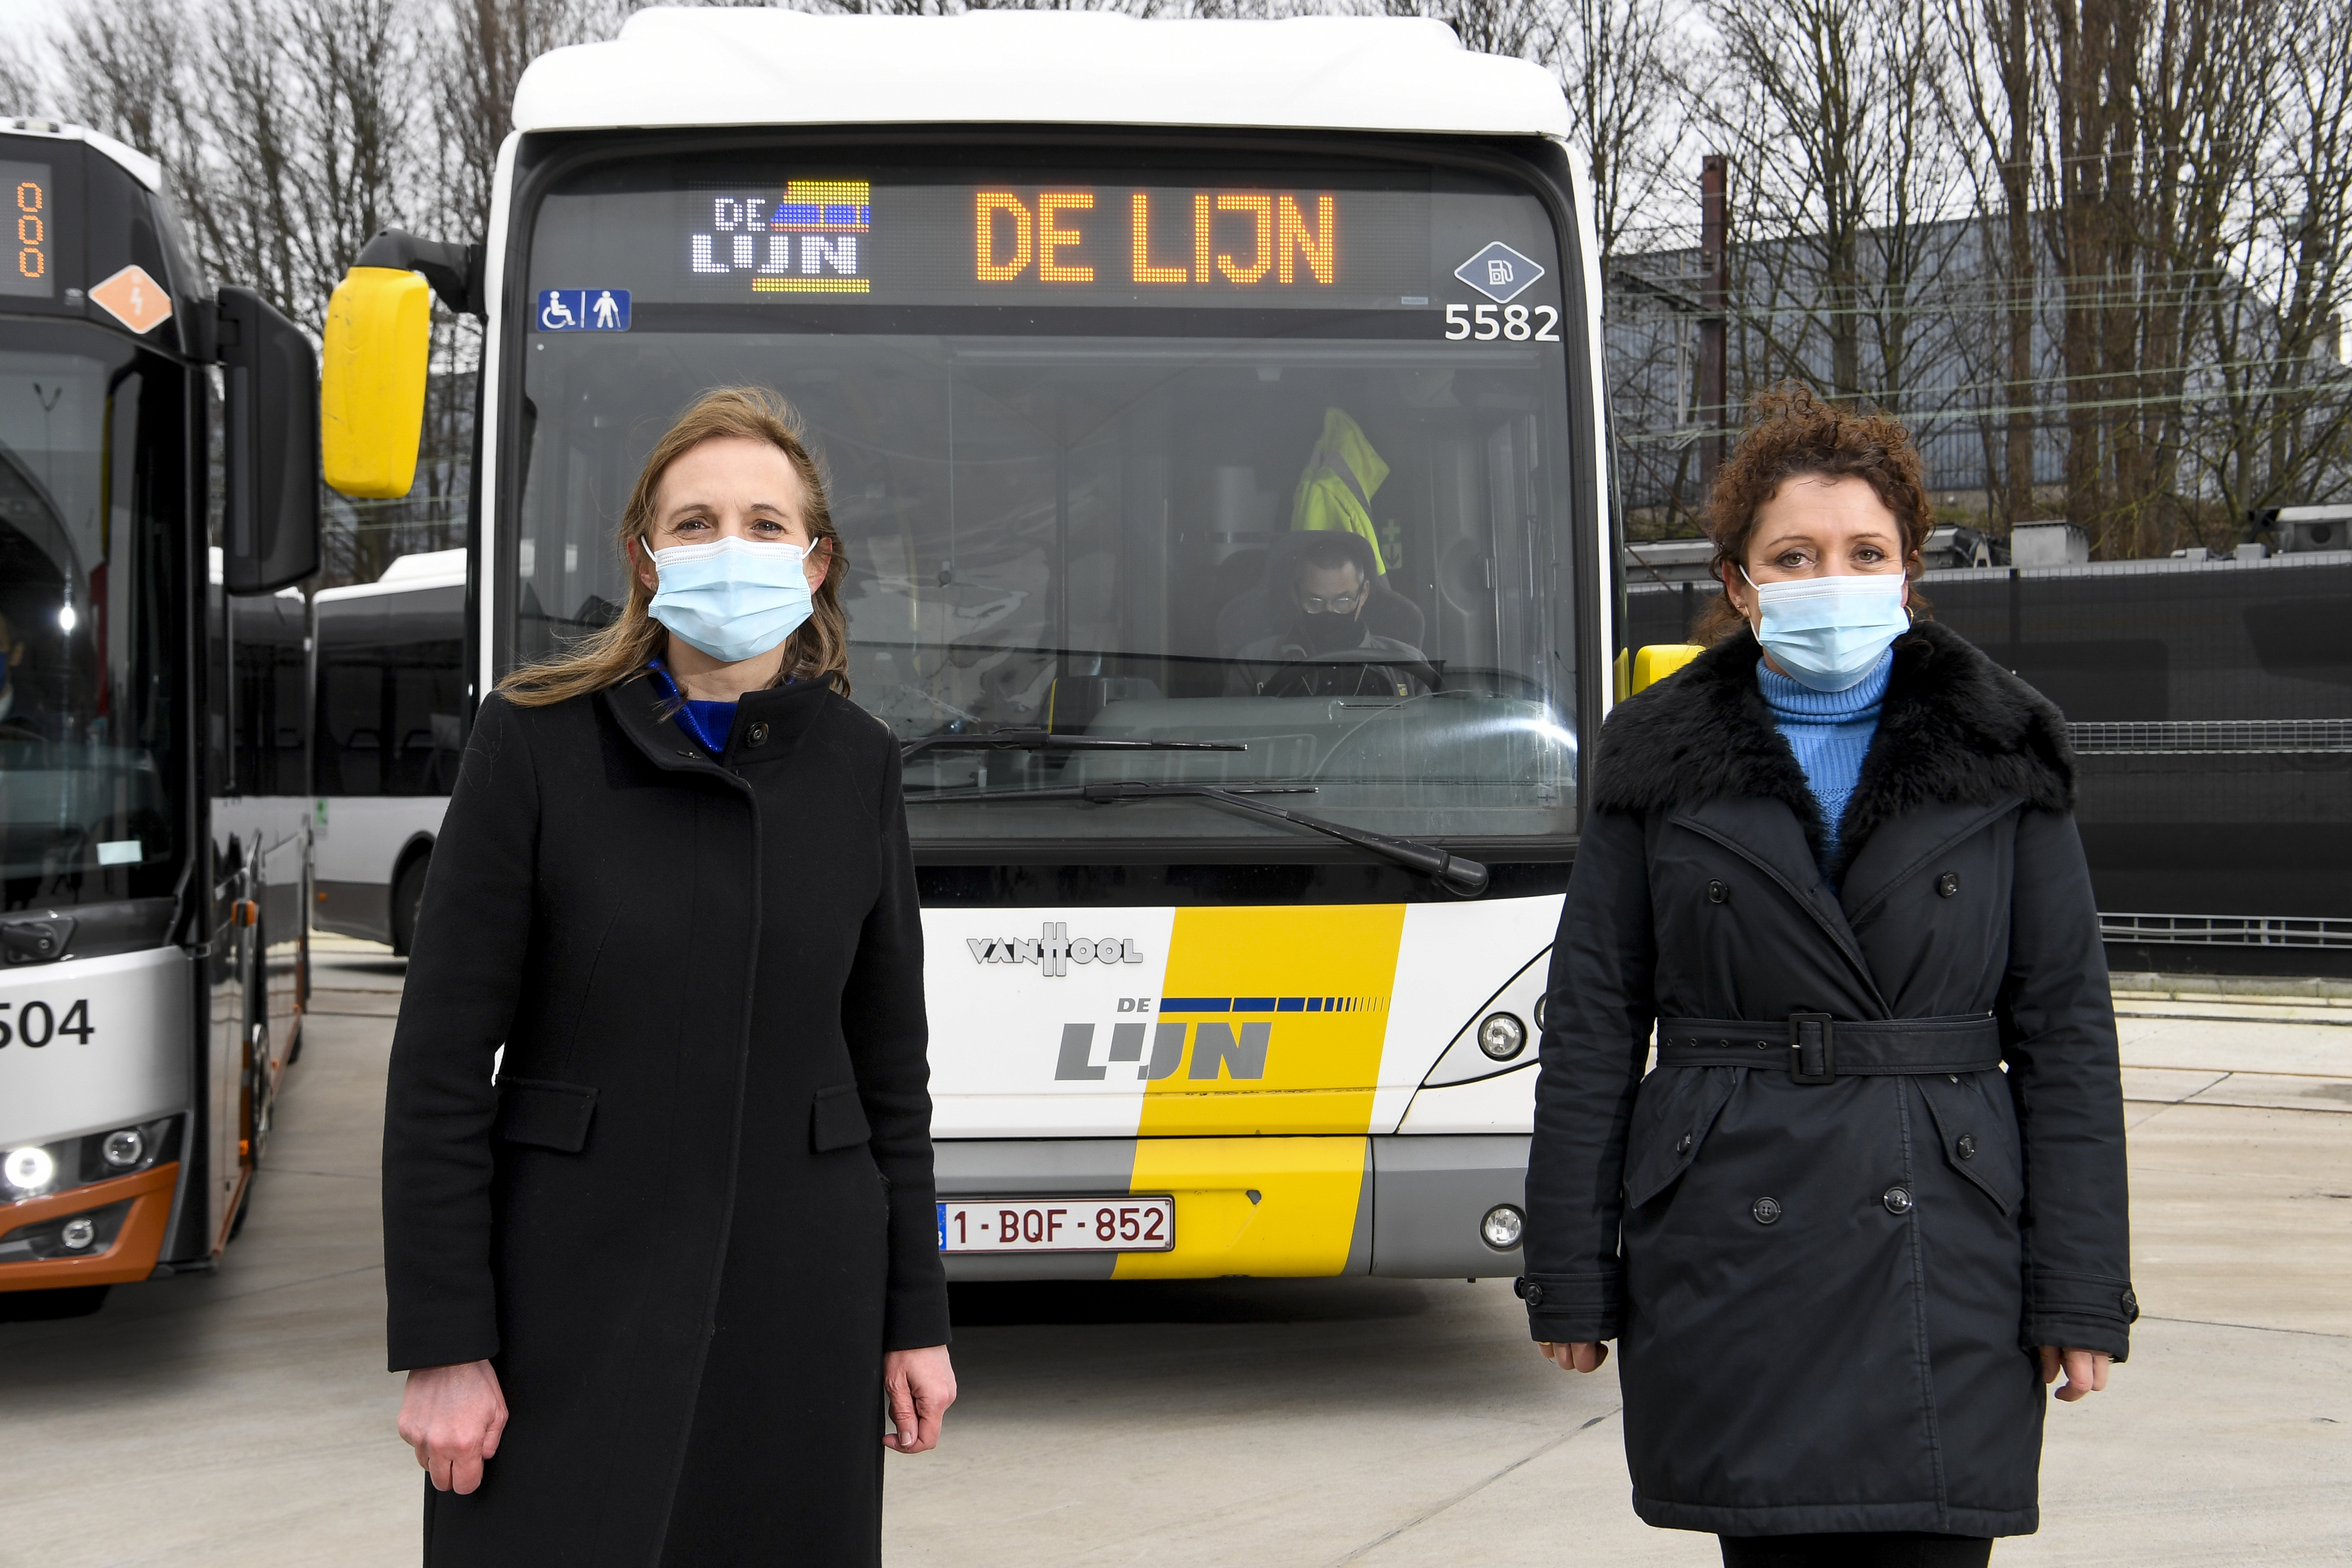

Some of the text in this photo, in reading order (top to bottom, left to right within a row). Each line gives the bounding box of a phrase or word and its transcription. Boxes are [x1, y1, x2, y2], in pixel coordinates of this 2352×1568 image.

[715, 198, 766, 232] DE
[692, 234, 857, 274] LIJN
[976, 192, 1334, 284] DE LIJN
[1445, 304, 1560, 342] 5582
[1117, 998, 1151, 1013] DE
[1054, 1022, 1271, 1081] LIJN
